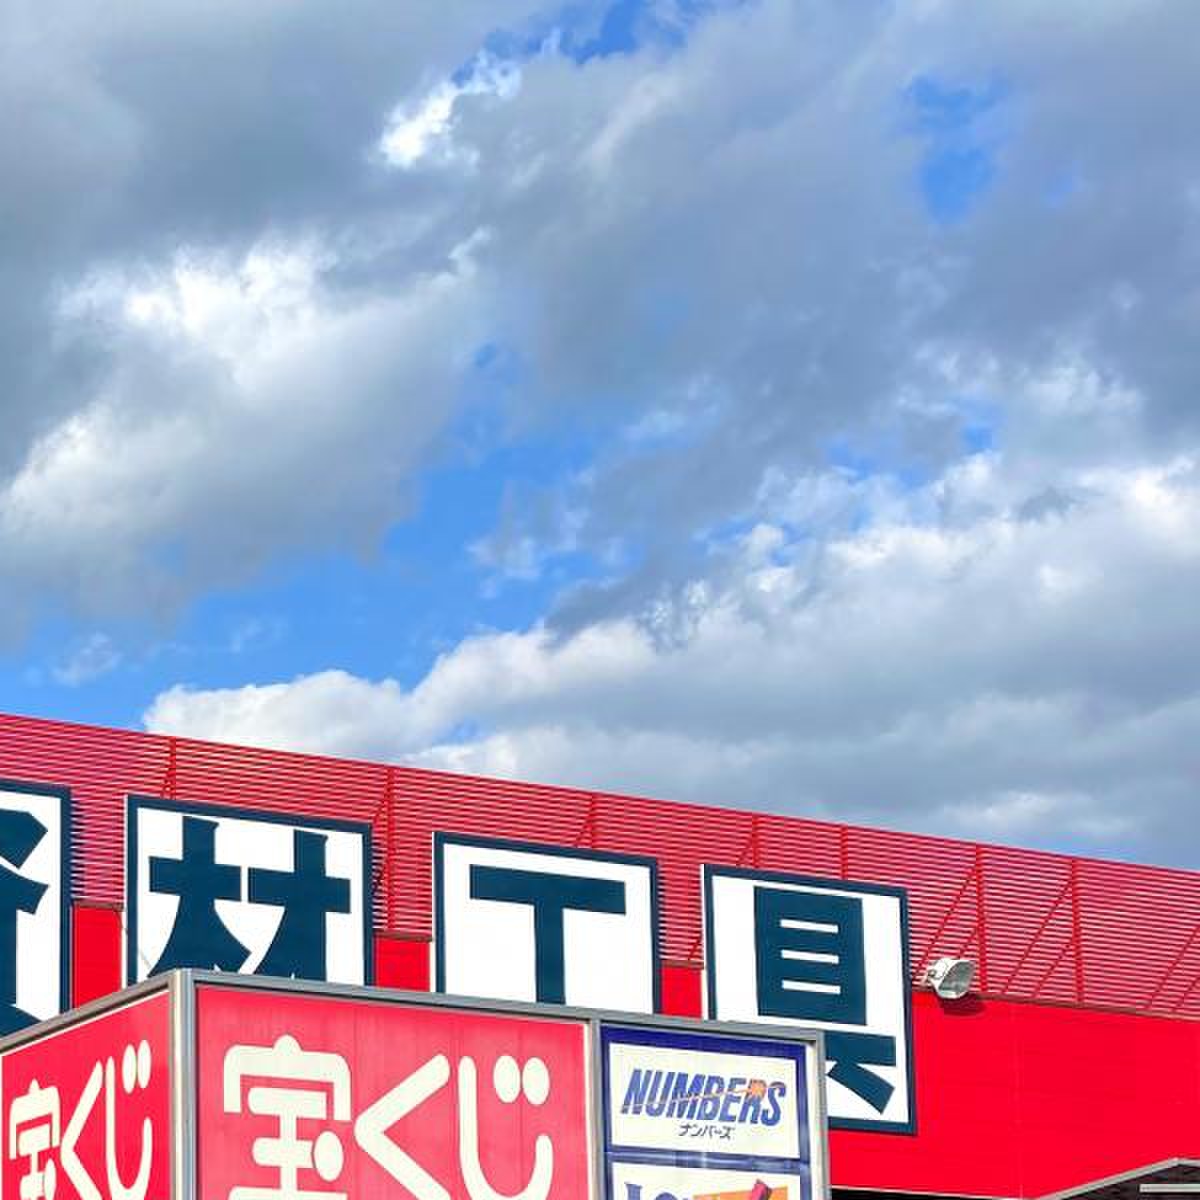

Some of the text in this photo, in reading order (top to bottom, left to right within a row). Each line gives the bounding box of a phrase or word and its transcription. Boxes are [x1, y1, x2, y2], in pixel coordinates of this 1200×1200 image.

[620, 1068, 787, 1127] NUMBERS
[678, 1122, 736, 1140] ナンバーズ
